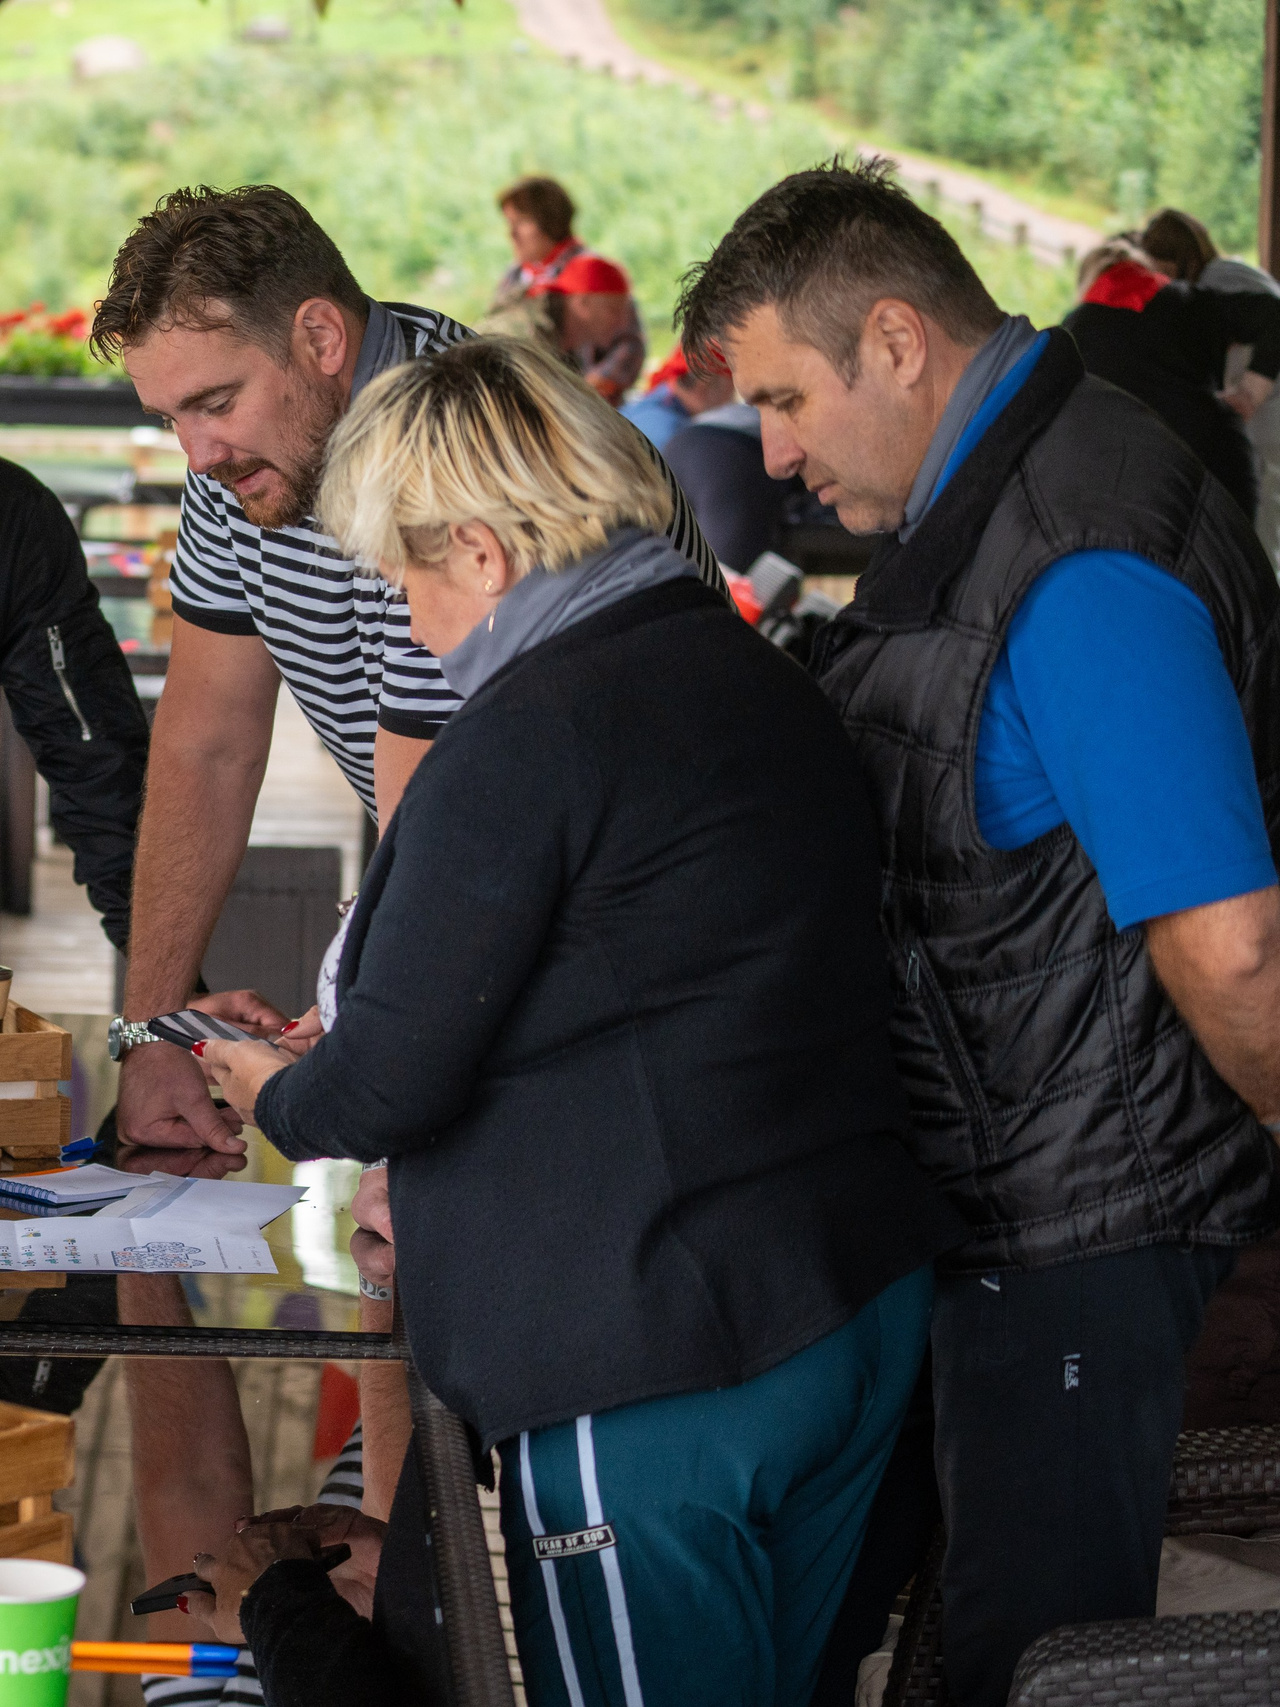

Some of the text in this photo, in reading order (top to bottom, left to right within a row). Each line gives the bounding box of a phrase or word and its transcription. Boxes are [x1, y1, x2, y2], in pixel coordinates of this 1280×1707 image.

[538, 1530, 604, 1551] FEAR OF GOD
